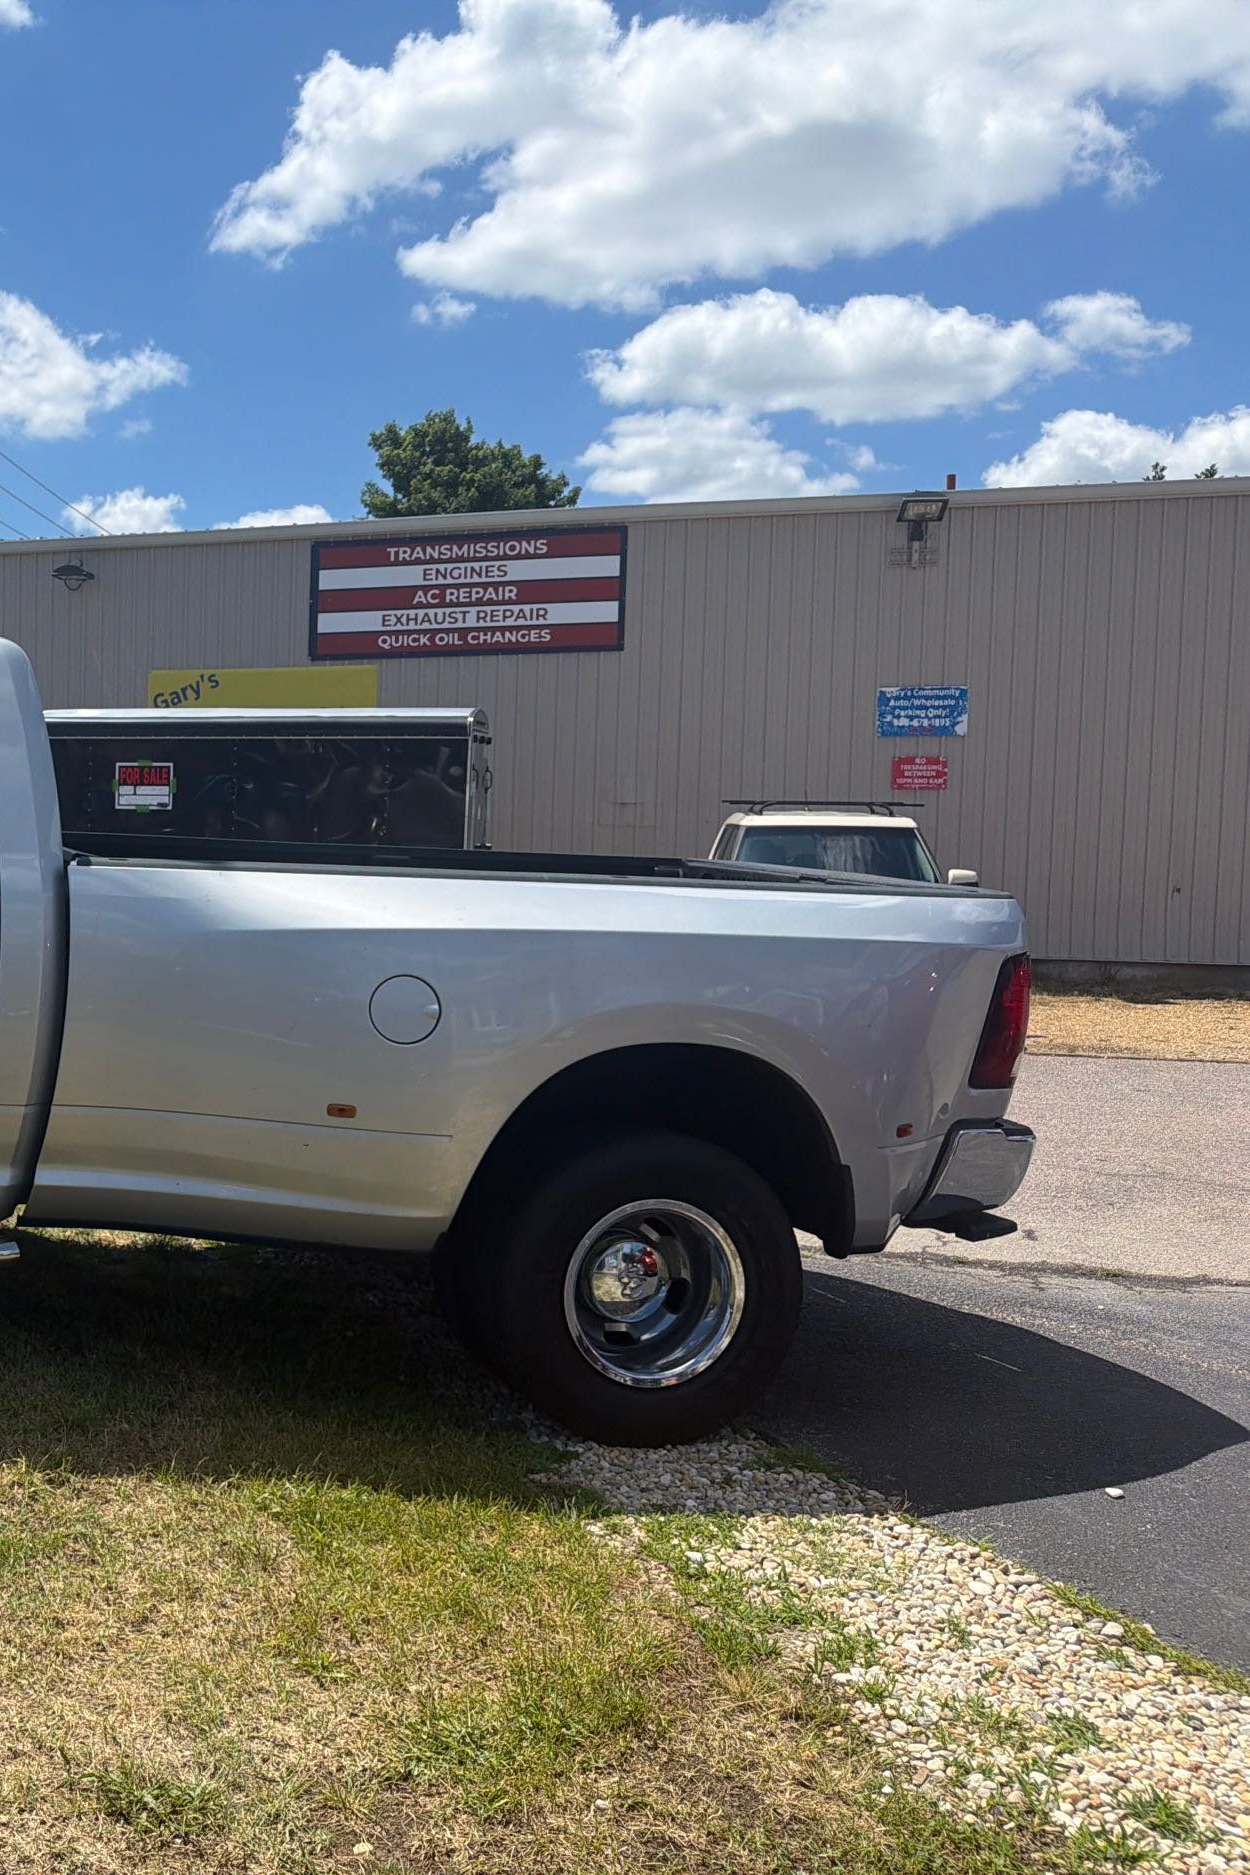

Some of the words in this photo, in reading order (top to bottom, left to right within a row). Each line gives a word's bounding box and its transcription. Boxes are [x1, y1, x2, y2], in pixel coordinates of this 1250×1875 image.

[387, 539, 548, 562] TRANSMISSIONS
[422, 564, 508, 582] ENGINES
[413, 589, 440, 605] AC
[445, 586, 518, 603] REPAIR
[381, 610, 470, 628] EXHAUST
[476, 607, 549, 624] REPAIR
[378, 633, 431, 650] QUICK
[435, 632, 463, 646] OIL
[467, 629, 551, 645] CHANGES
[152, 673, 220, 709] Gary's
[913, 688, 960, 698] Community
[889, 699, 956, 708] Auto/Wholesale
[894, 709, 926, 718] Parking
[927, 708, 950, 717] Only!
[120, 767, 140, 785] FOR
[143, 767, 169, 785] SALE
